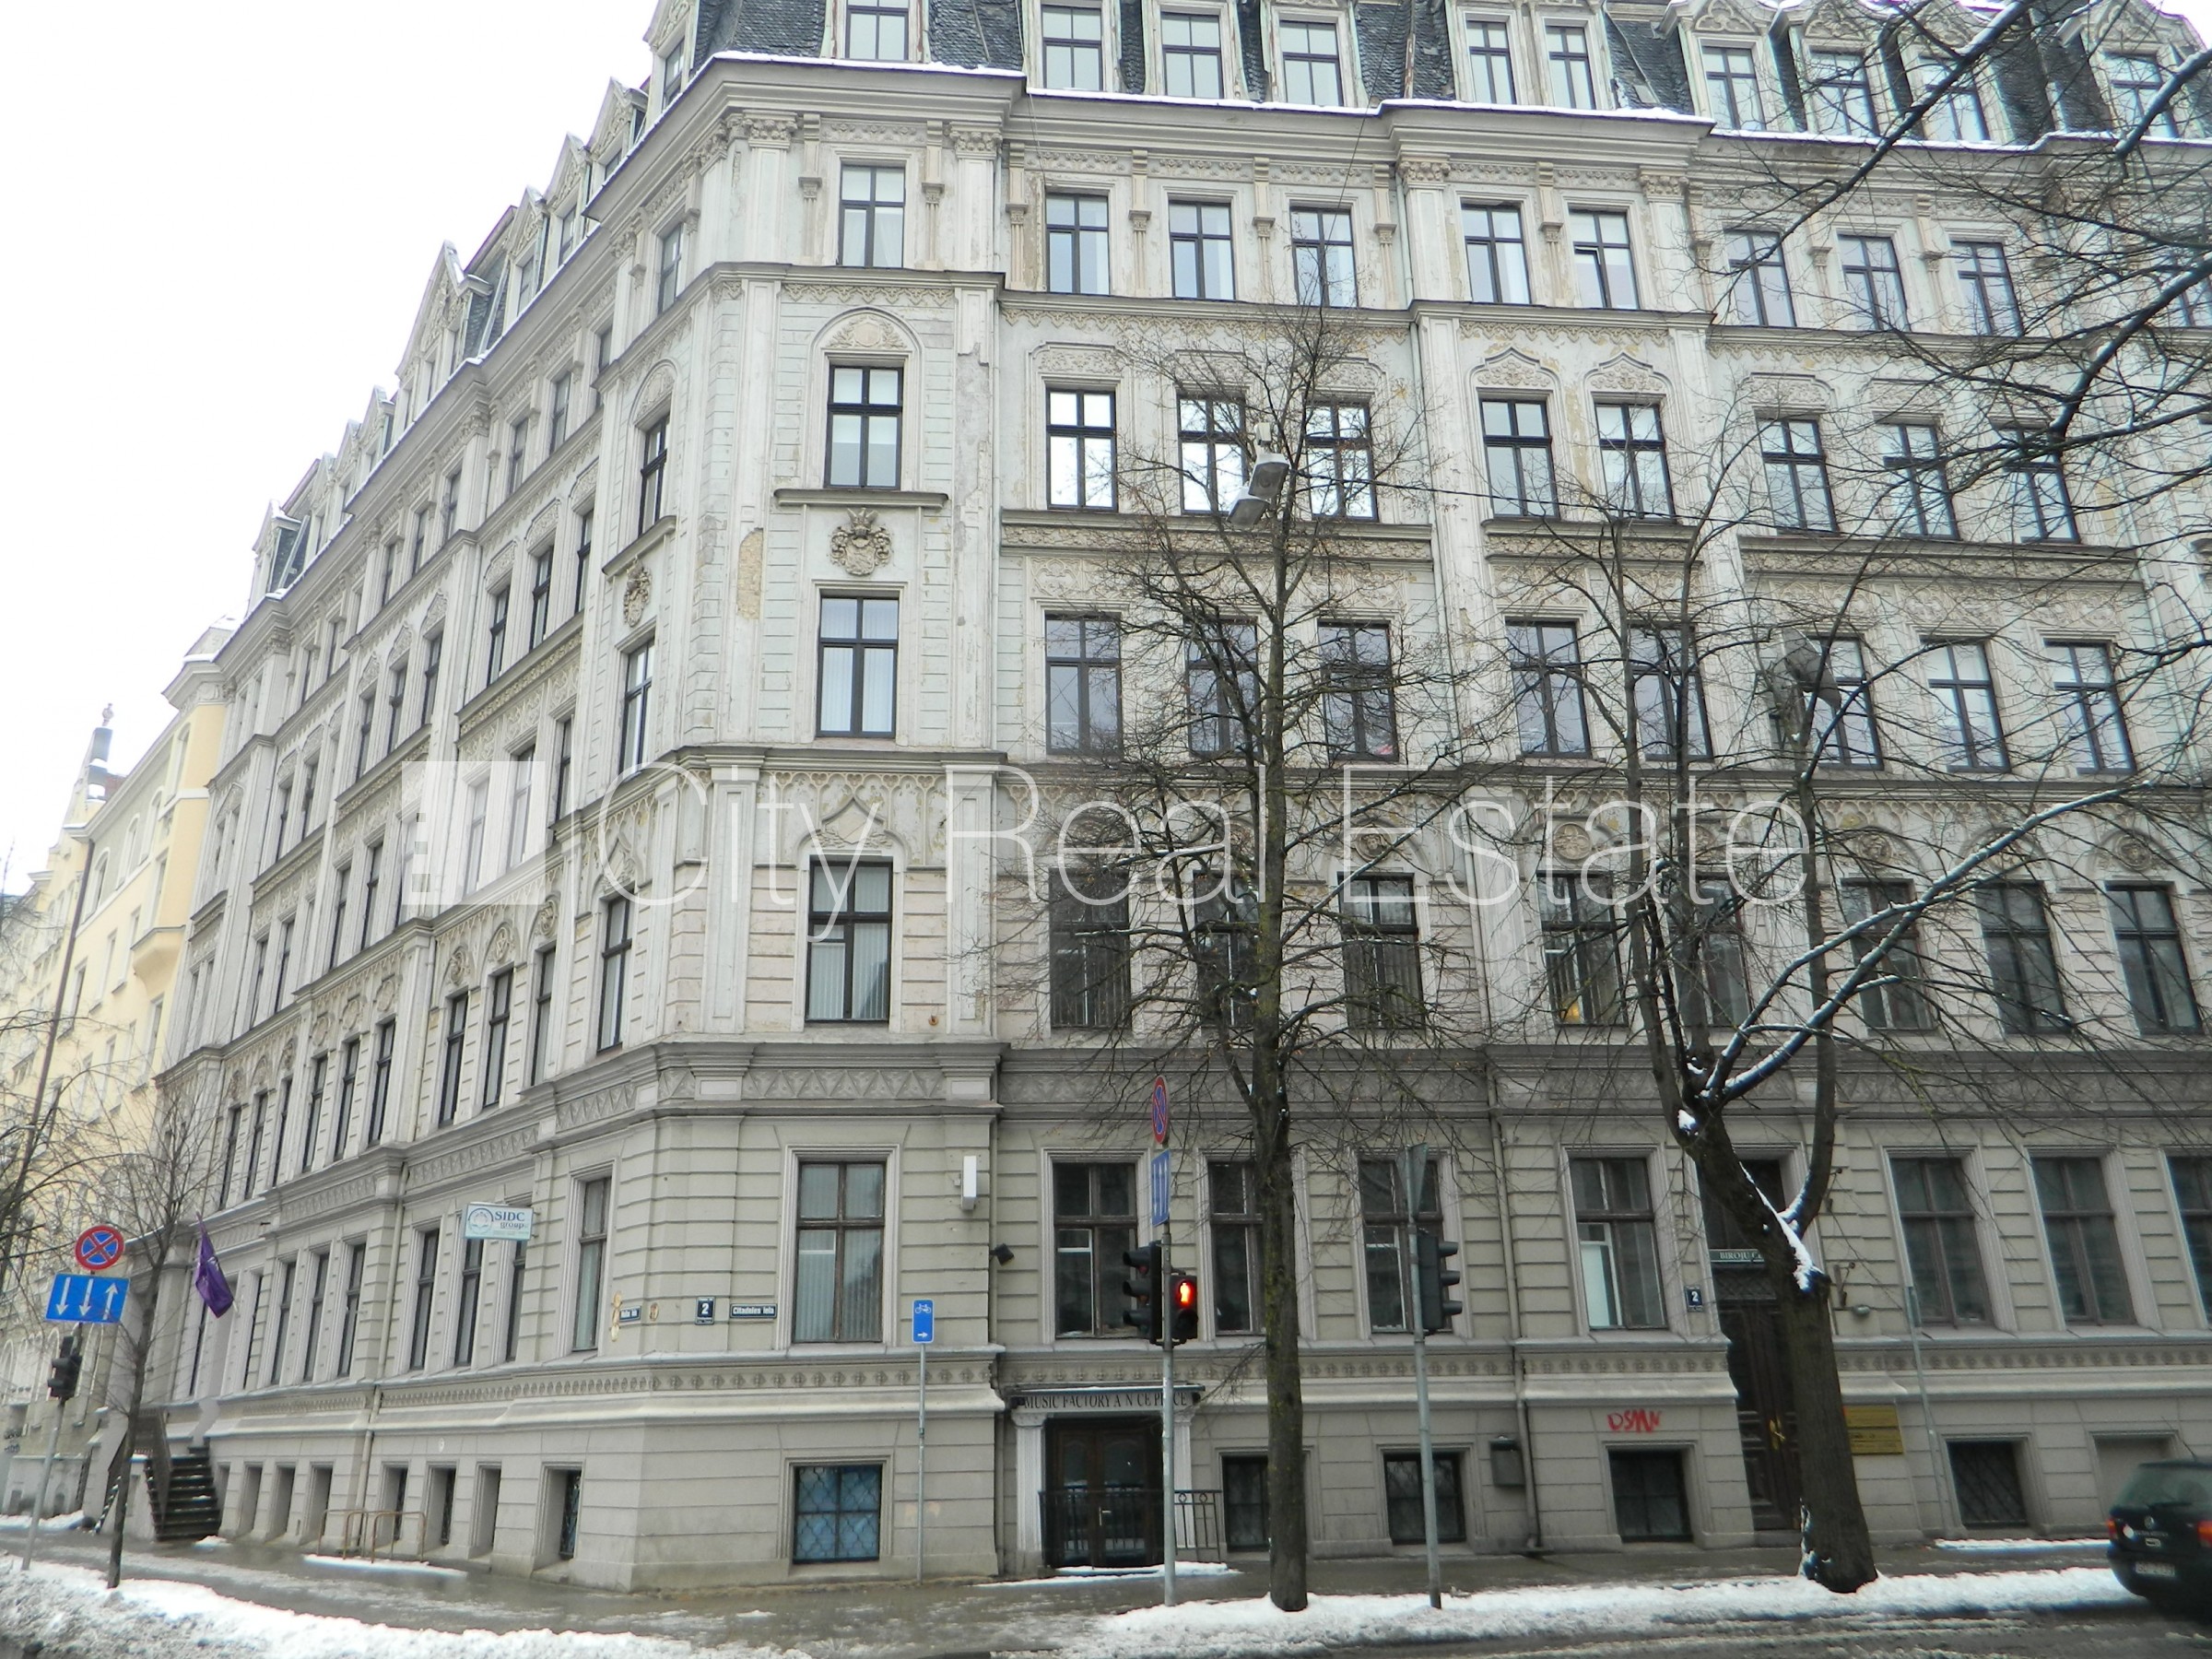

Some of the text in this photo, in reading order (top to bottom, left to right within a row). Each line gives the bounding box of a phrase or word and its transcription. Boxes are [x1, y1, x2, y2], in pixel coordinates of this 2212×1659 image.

[494, 1211, 524, 1221] SIDC
[500, 1221, 524, 1230] group
[1691, 1291, 1699, 1301] 2
[701, 1302, 710, 1314] 2
[1025, 1394, 1058, 1409] MUSIC
[1063, 1394, 1110, 1408] FACTORY
